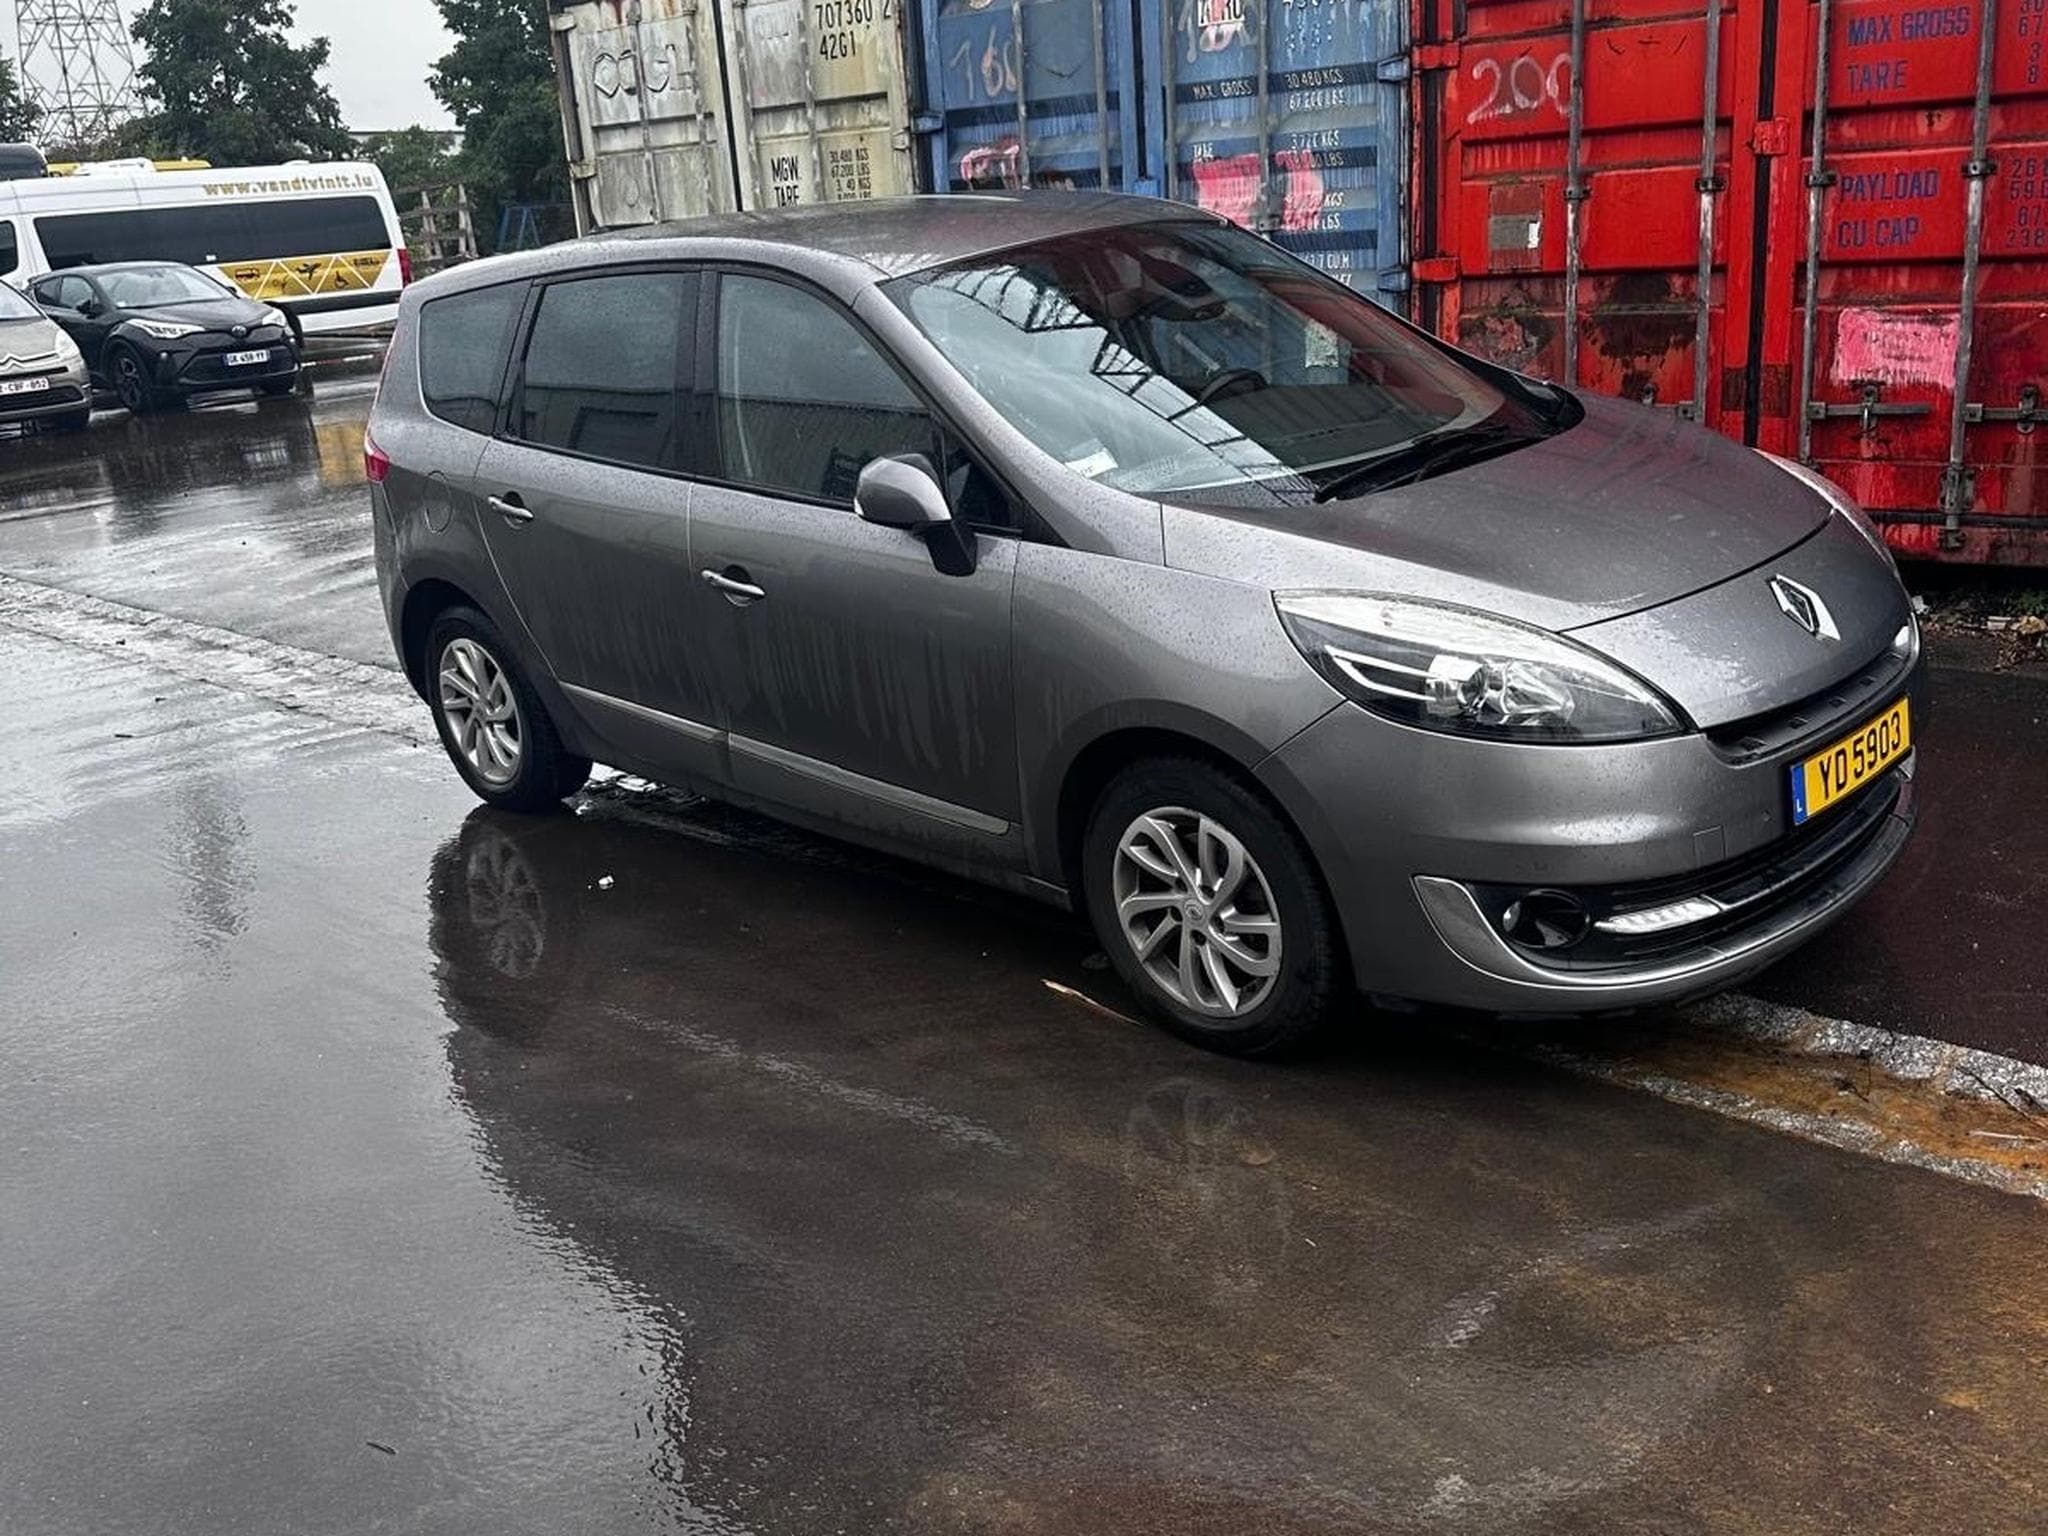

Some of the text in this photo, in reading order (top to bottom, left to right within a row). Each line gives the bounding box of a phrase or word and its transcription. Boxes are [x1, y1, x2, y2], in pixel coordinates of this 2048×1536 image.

[1849, 7, 1970, 46] MAX GROSS
[819, 31, 856, 61] 42G1
[1220, 80, 1253, 97] GROSS
[1848, 60, 1909, 92] TARE
[1840, 169, 1939, 203] PAYLOAD
[1838, 216, 1919, 248] CU CAP
[1796, 711, 1901, 813] L YD 5903
